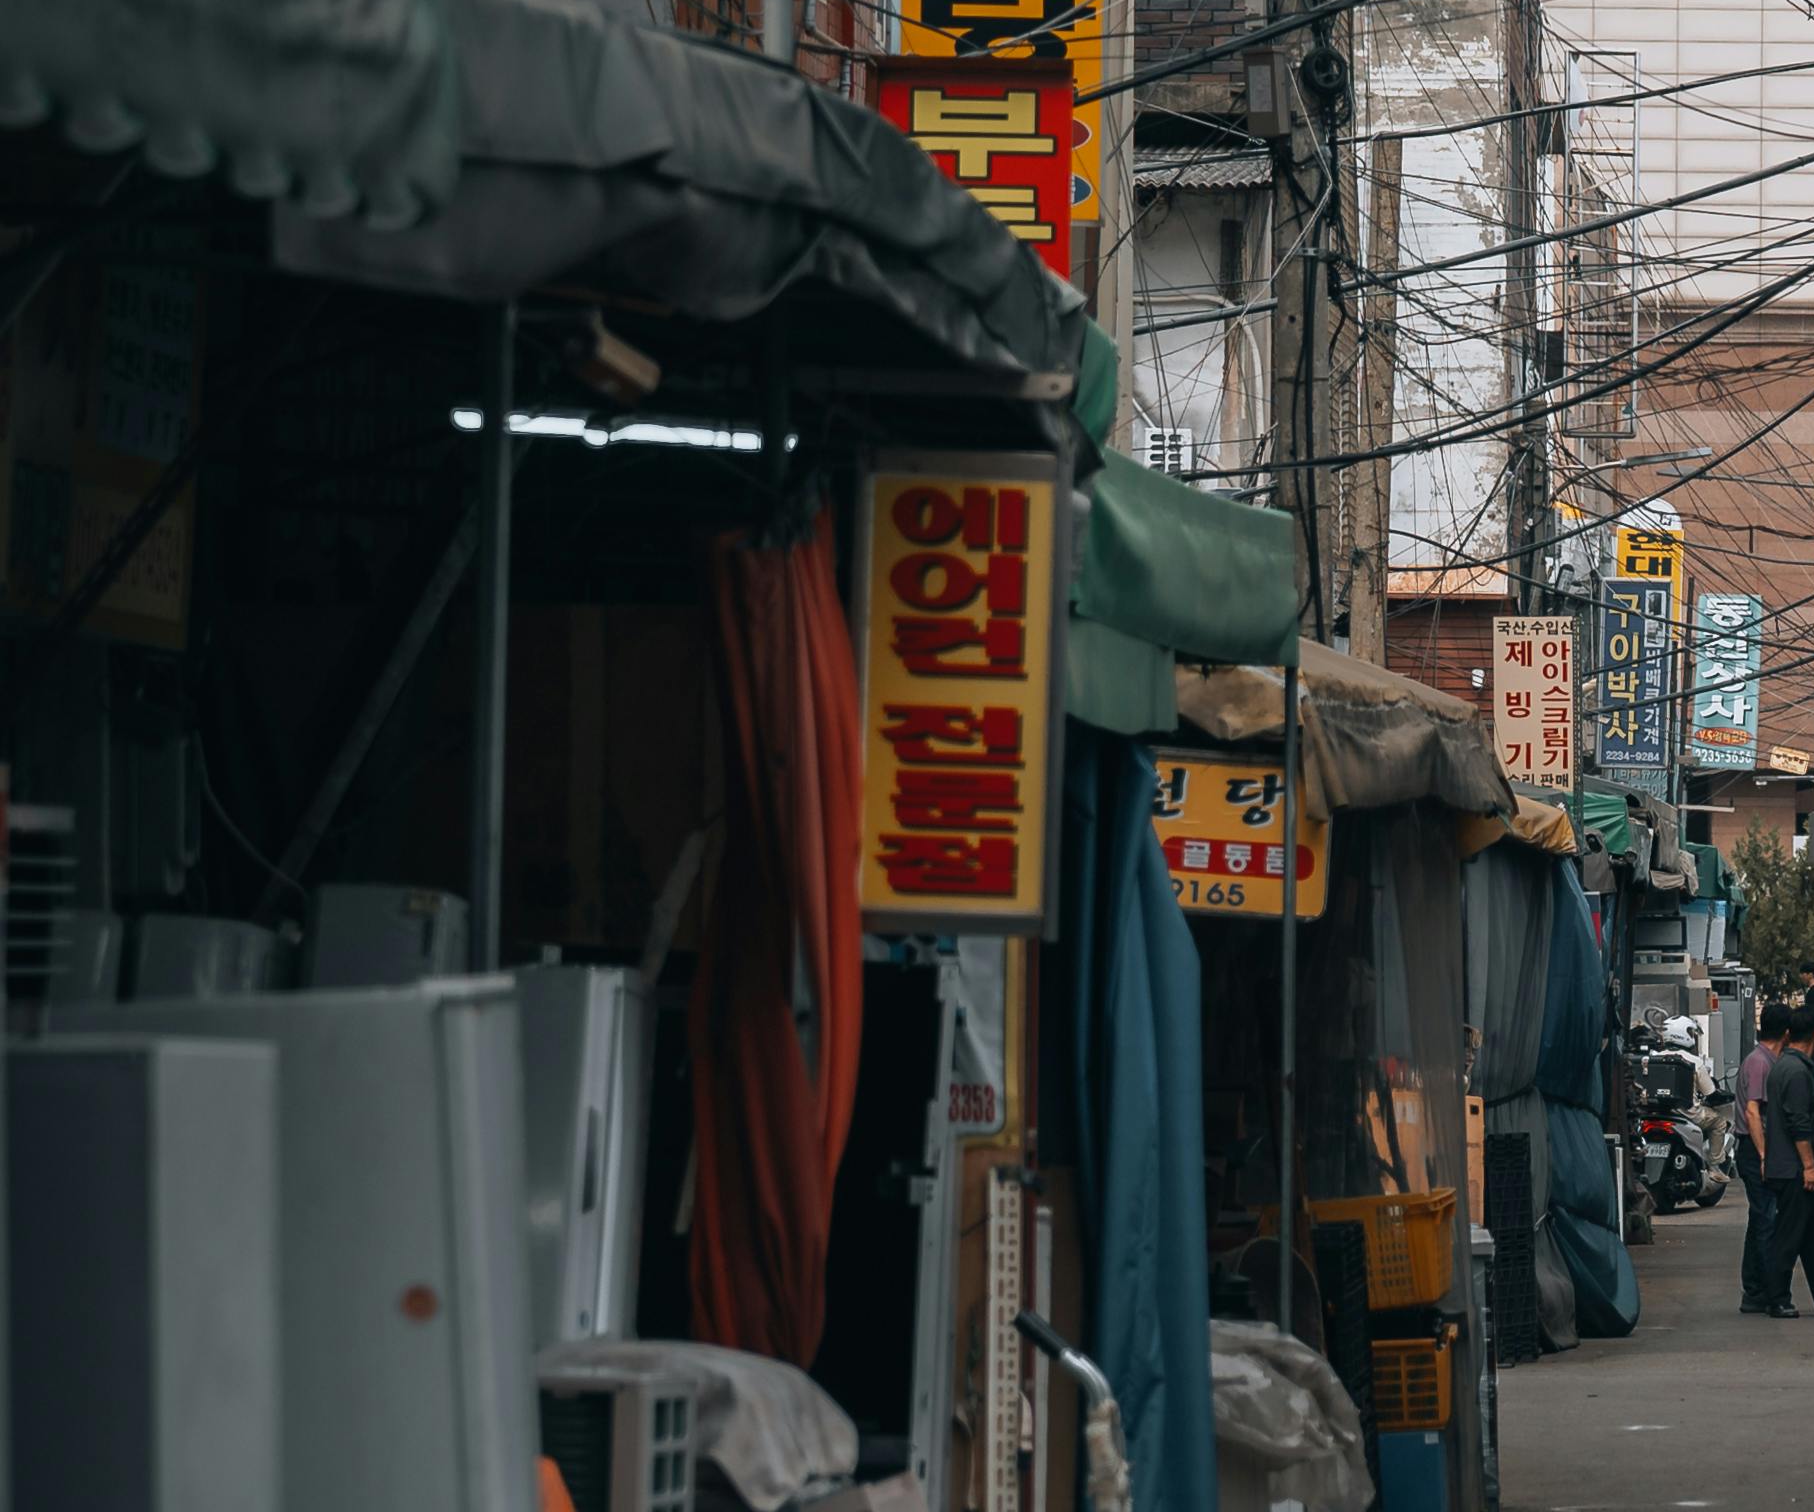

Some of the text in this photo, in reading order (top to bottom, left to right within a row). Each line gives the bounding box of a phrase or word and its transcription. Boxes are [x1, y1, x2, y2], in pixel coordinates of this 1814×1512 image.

[875, 487, 1029, 898] 에어컨 전문점
[1504, 640, 1533, 770] 제빙기
[1540, 640, 1571, 770] 아이스크림기
[1605, 593, 1642, 746] 구이박사
